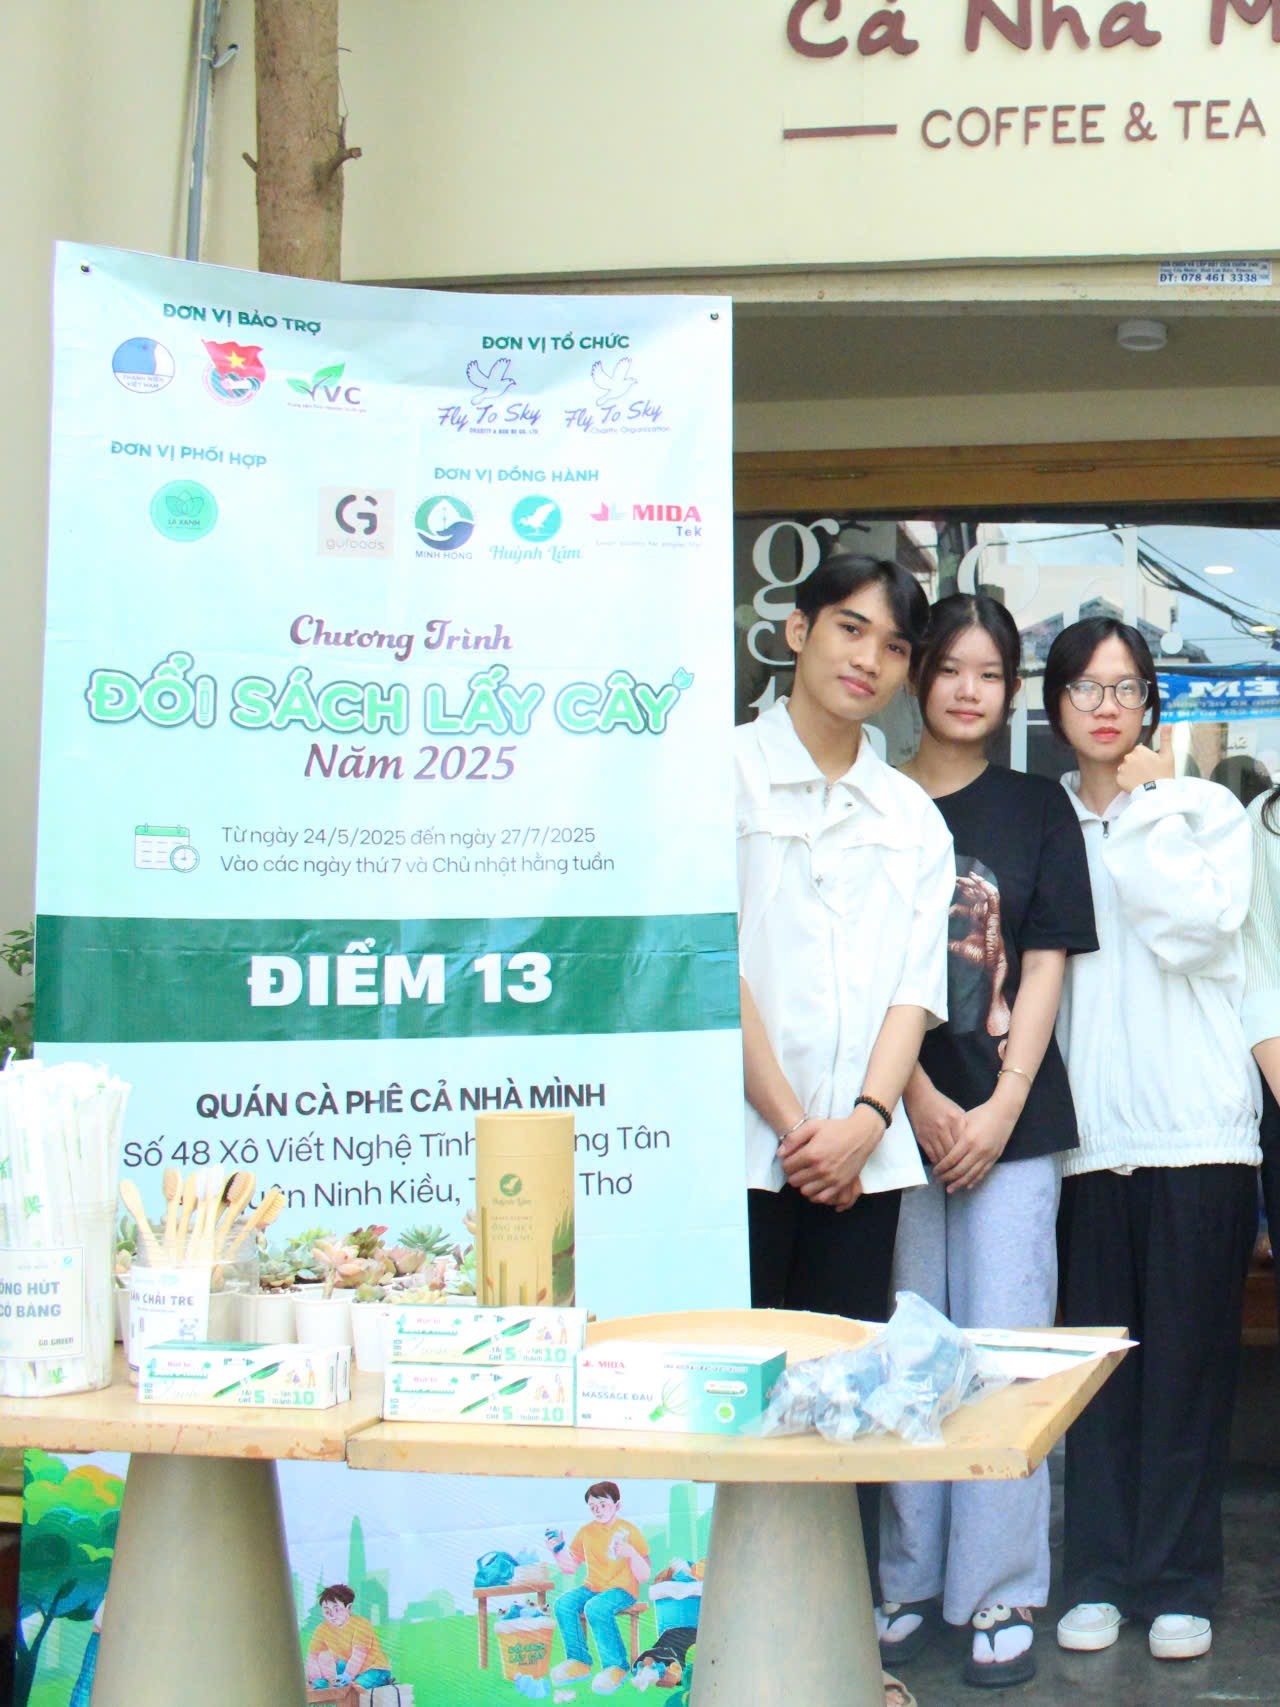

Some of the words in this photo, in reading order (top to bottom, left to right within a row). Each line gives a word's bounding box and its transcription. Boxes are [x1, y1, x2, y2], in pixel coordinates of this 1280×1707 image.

[921, 104, 1106, 149] COFFEE
[1125, 101, 1157, 141] &
[1173, 98, 1266, 141] TEA
[1181, 273, 1201, 282] 078
[1206, 273, 1225, 281] 461
[163, 303, 206, 322] ĐƠN
[212, 308, 232, 327] VỊ
[238, 309, 277, 328] BẢO
[282, 317, 322, 336] TRỢ
[482, 335, 523, 350] ĐƠN
[528, 337, 546, 354] VỊ
[551, 331, 575, 350] TỔ
[579, 333, 630, 350] CHỨC
[437, 405, 469, 432] Fly
[475, 404, 498, 425] To
[504, 402, 542, 426] Sky
[564, 407, 594, 432] Fly
[601, 404, 621, 425] To
[627, 399, 663, 423] Sky
[110, 440, 151, 457] ĐƠN
[157, 444, 175, 462] VỊ
[180, 445, 224, 463] PHỐI
[229, 451, 267, 470] HỢP
[433, 467, 472, 483] ĐƠN
[476, 469, 493, 485] VỊ
[551, 467, 599, 484] HÀNH
[632, 504, 702, 523] MIDA
[415, 549, 440, 560] MINH
[289, 614, 414, 661] Chương
[424, 620, 513, 651] Trình
[85, 651, 217, 727] ĐỔI
[231, 666, 409, 734] SÁCH
[424, 664, 545, 735] LẤY
[554, 669, 683, 735] CÂY
[304, 742, 405, 781] Năm
[413, 744, 516, 782] 2025
[221, 826, 246, 844] Từ
[250, 829, 299, 850] ngày
[303, 826, 406, 848] 24/5/2025
[411, 824, 446, 846] đến
[450, 828, 496, 850] ngày
[501, 826, 596, 847] 27/7/2025
[221, 853, 258, 872] Vào
[263, 854, 299, 873] các
[303, 855, 351, 877] ngày
[354, 853, 389, 874] thứ
[391, 856, 402, 874] 7
[406, 855, 428, 873] và
[432, 851, 470, 873] Chủ
[474, 853, 516, 877] nhật
[572, 852, 615, 872] tuần
[247, 938, 445, 1007] ĐIỂM
[474, 951, 552, 1003] 13
[196, 1084, 288, 1119] QUÁN
[295, 1082, 339, 1115] CÀ
[346, 1083, 403, 1114] PHÊ
[410, 1079, 453, 1113] CẢ
[460, 1078, 523, 1110] NHÀ
[530, 1076, 606, 1108] MÌNH
[123, 1135, 164, 1167] Số
[171, 1140, 210, 1165] 48
[220, 1138, 258, 1164] Xô
[266, 1131, 325, 1163] Viết
[333, 1133, 412, 1167] Nghệ
[617, 1125, 670, 1150] Tân
[314, 1180, 384, 1207] Ninh
[390, 1172, 461, 1206] Kiều,
[579, 1170, 632, 1196] Thơ
[170, 1295, 195, 1307] TRE
[505, 1347, 516, 1361] 5
[544, 1348, 567, 1362] 10
[254, 1389, 265, 1404] 5
[293, 1390, 315, 1405] 10
[582, 1391, 629, 1401] MASSAGE
[502, 1406, 513, 1420] 5
[541, 1407, 564, 1421] 10
